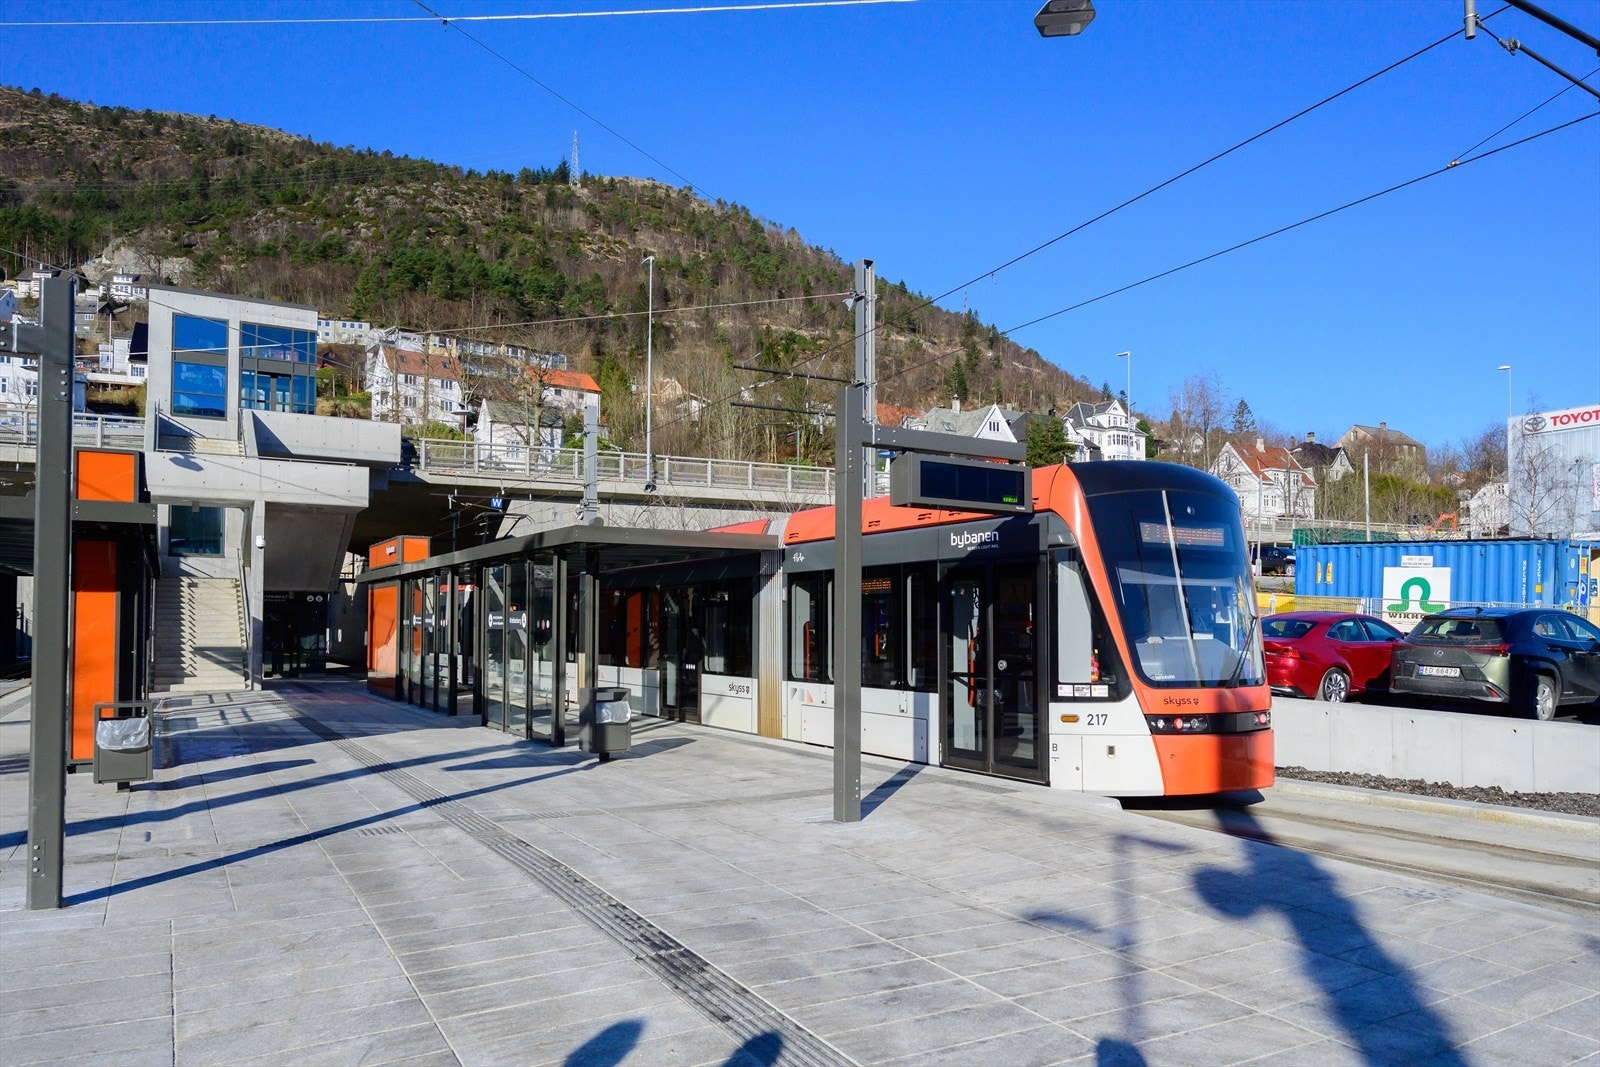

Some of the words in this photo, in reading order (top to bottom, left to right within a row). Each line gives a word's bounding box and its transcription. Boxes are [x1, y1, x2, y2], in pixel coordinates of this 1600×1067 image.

[492, 498, 502, 507] W
[950, 531, 999, 549] bybanen
[728, 682, 746, 695] skyss
[1163, 696, 1192, 707] skyss
[1087, 713, 1108, 726] 217
[1052, 743, 1058, 752] B
